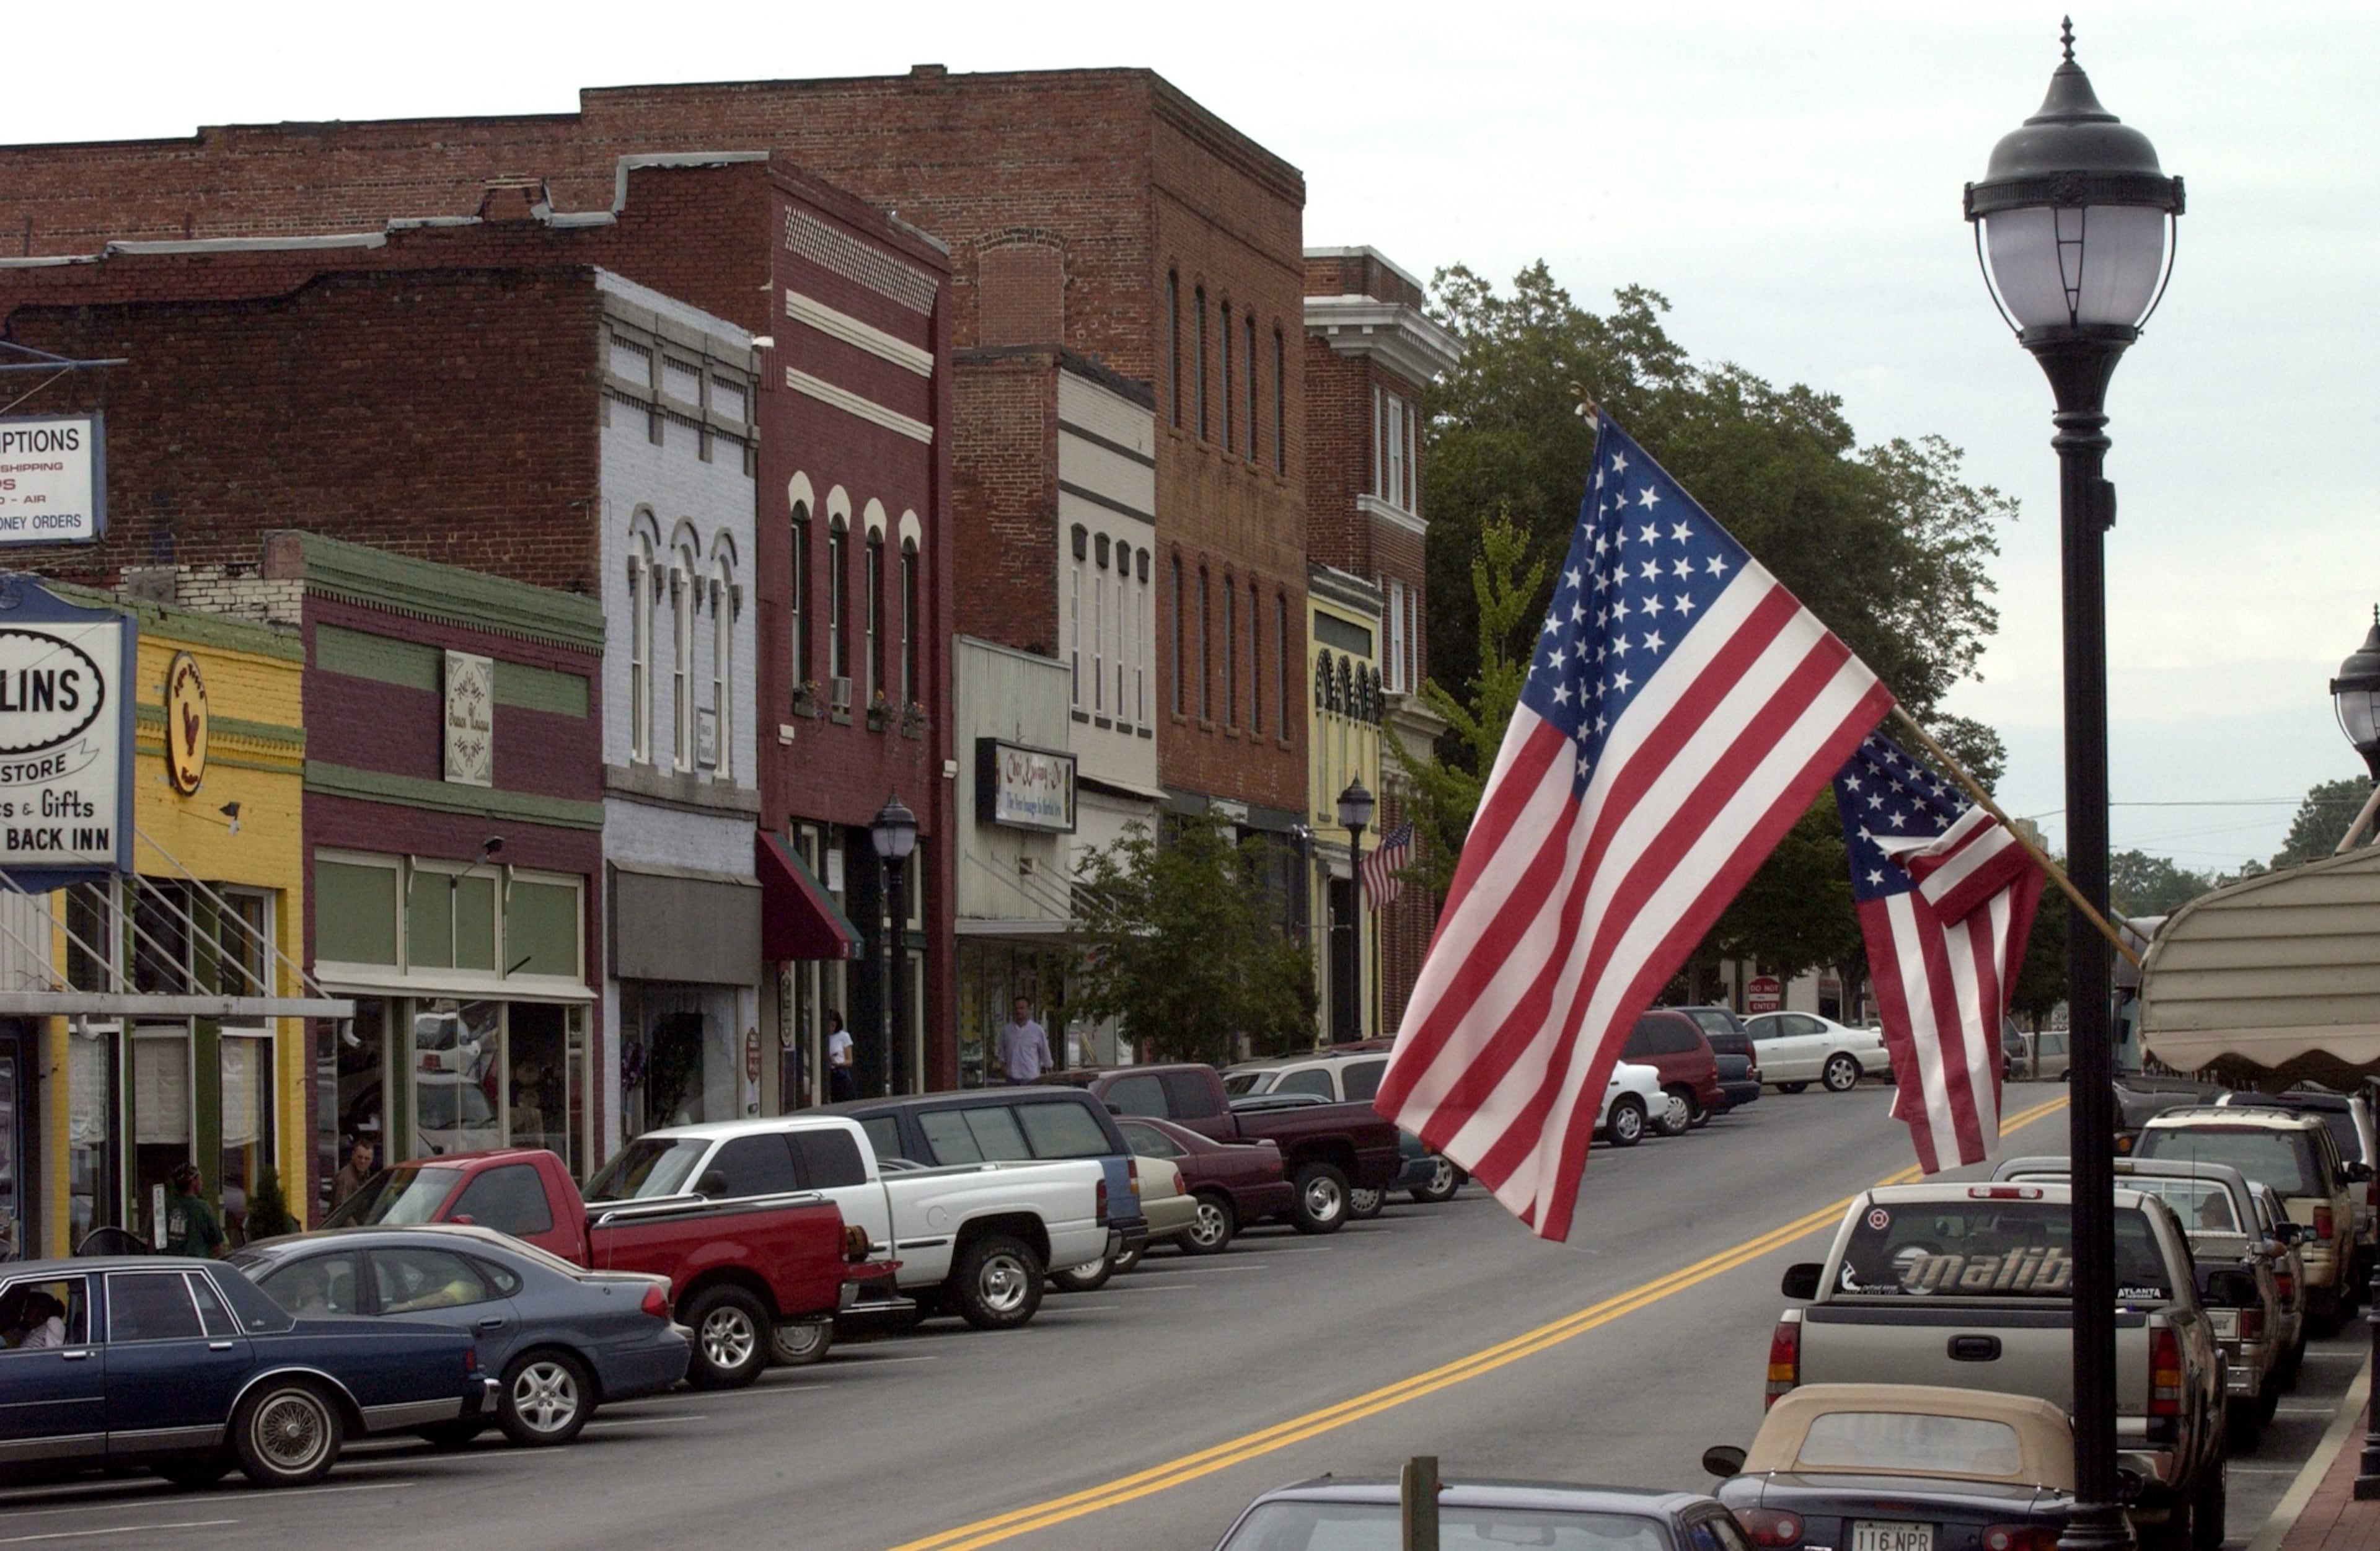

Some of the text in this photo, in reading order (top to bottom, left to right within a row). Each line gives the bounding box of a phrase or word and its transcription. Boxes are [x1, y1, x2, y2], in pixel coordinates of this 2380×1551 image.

[0, 428, 79, 454] PTIONS
[1, 462, 63, 473] SHIPPING
[24, 495, 46, 504] AIR
[33, 514, 81, 529] ORDERS
[0, 669, 79, 712] LINS
[1, 753, 66, 782] STORE
[22, 803, 35, 816] &
[42, 789, 94, 818] Gifts
[7, 828, 108, 850] BACK INN
[1750, 984, 1778, 992] DO NOT
[1753, 1002, 1776, 1010] ENTER
[1903, 1247, 2073, 1289] malib
[2117, 1288, 2161, 1299] ATLANTA
[1859, 1531, 1928, 1551] 116 NPR
